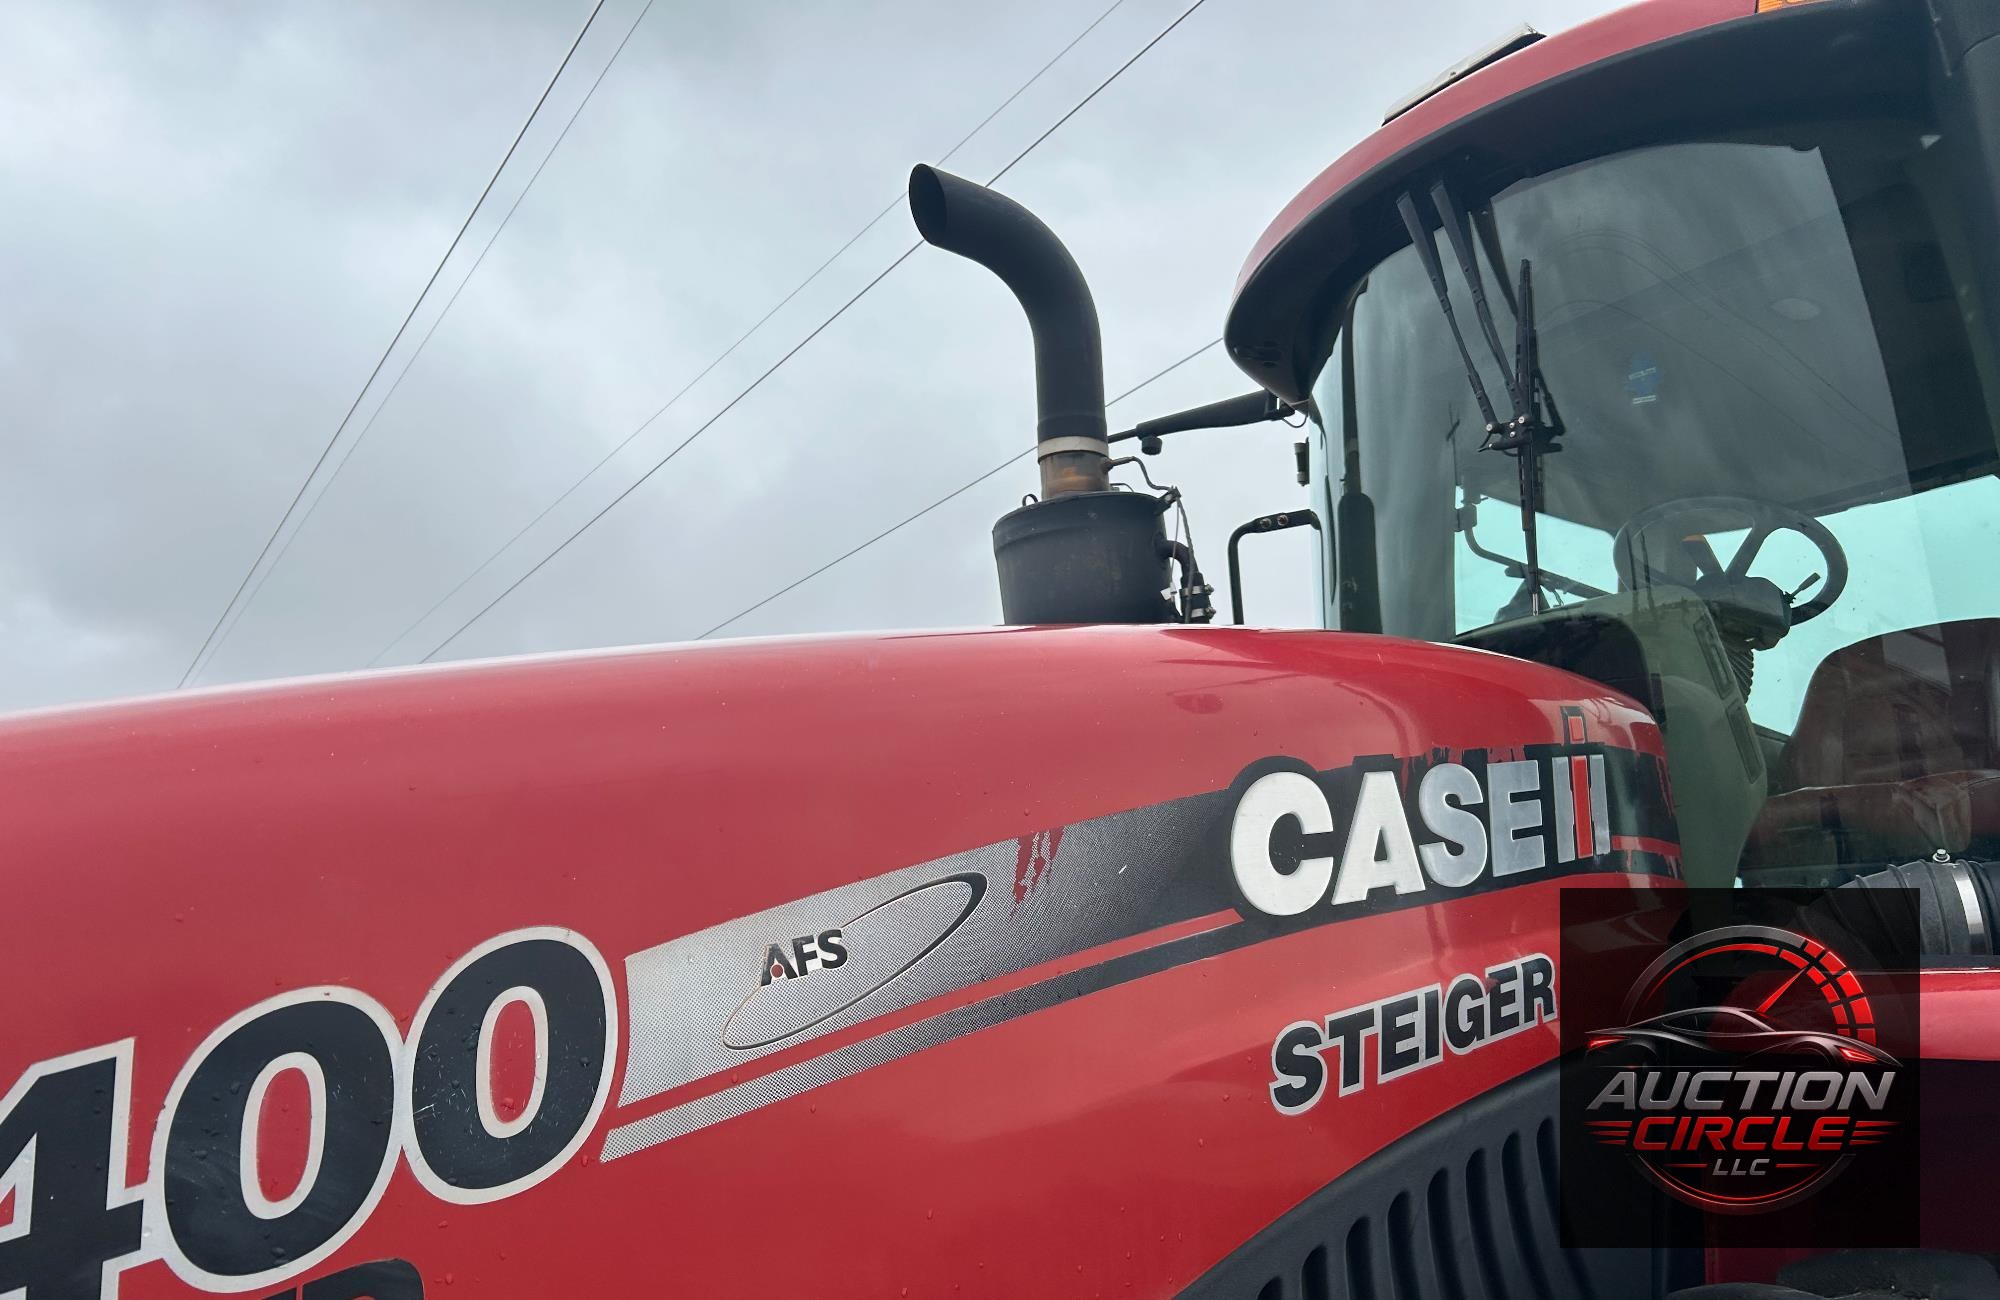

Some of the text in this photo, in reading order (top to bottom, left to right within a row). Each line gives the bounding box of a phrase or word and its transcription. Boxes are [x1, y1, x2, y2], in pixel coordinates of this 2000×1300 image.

[1230, 759, 1547, 916] CASE
[760, 928, 848, 987] AFS
[1269, 953, 1558, 1115] STEIGER
[0, 925, 618, 1300] 400
